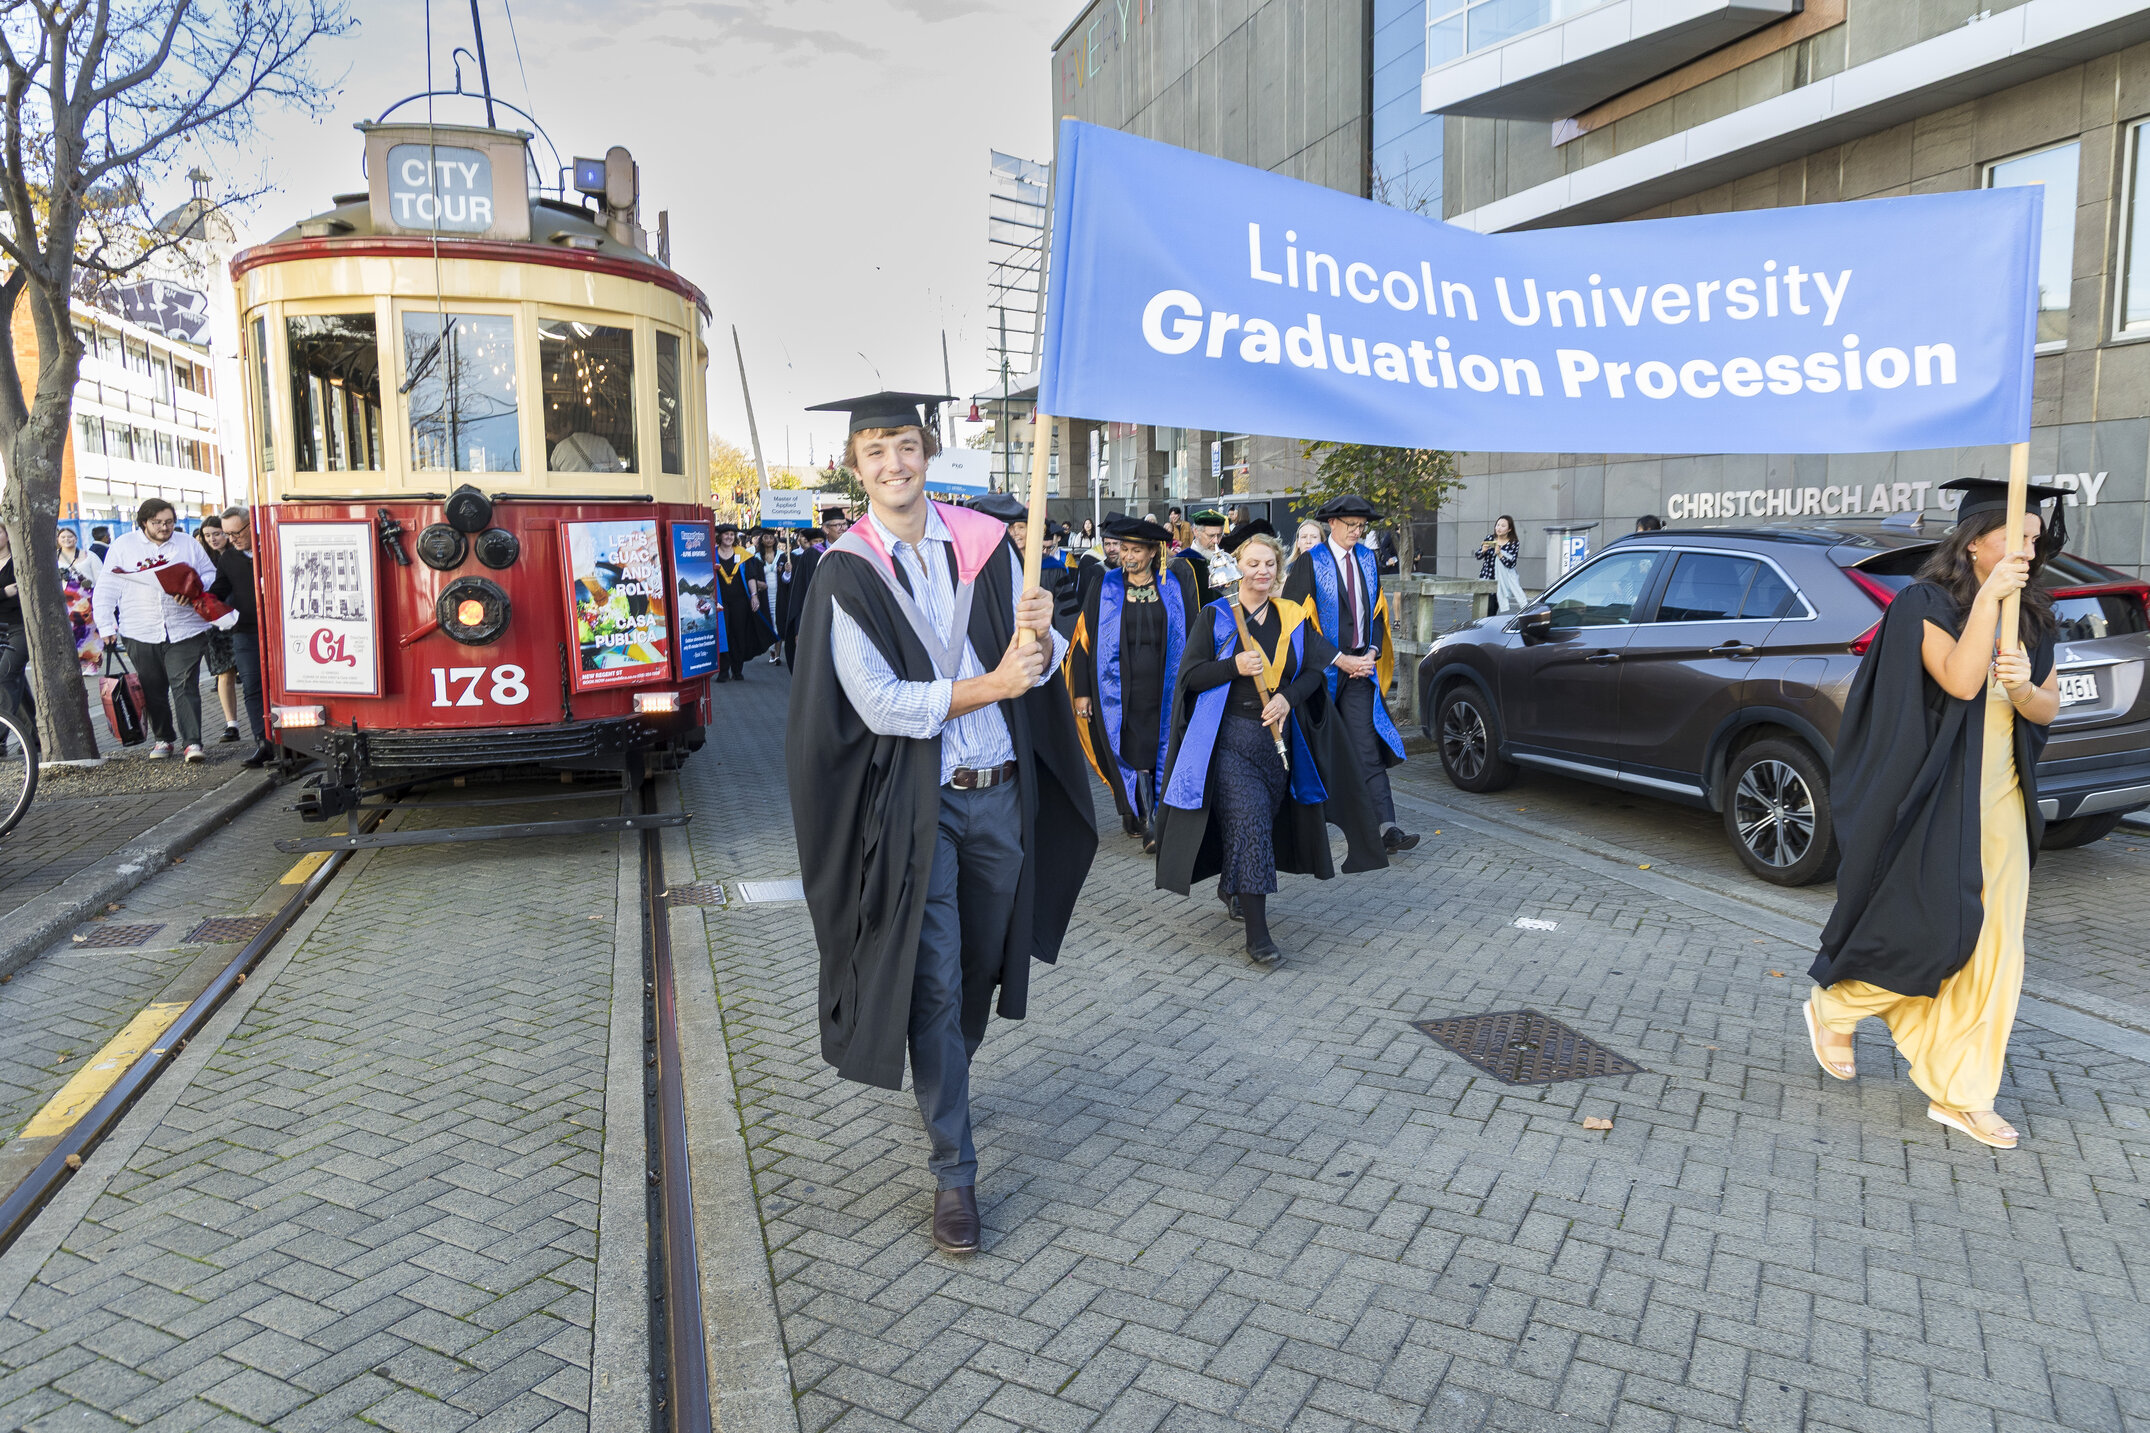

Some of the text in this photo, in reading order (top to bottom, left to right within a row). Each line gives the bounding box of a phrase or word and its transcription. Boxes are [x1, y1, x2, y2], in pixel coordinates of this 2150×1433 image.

[401, 158, 480, 189] CITY
[394, 192, 494, 224] TOUR
[1248, 221, 1853, 328] Lincoln University
[1141, 289, 1958, 400] Graduation Procession
[1667, 484, 1864, 520] CHRISTCHURCH
[1867, 480, 1933, 513] ART
[608, 533, 648, 548] LET'S
[1571, 537, 1585, 556] P
[608, 550, 650, 565] GUAC
[621, 566, 652, 581] AND
[615, 581, 654, 597] ROLL
[615, 613, 657, 630] CASA
[595, 630, 658, 649] PUBLICA
[430, 663, 530, 708] 178
